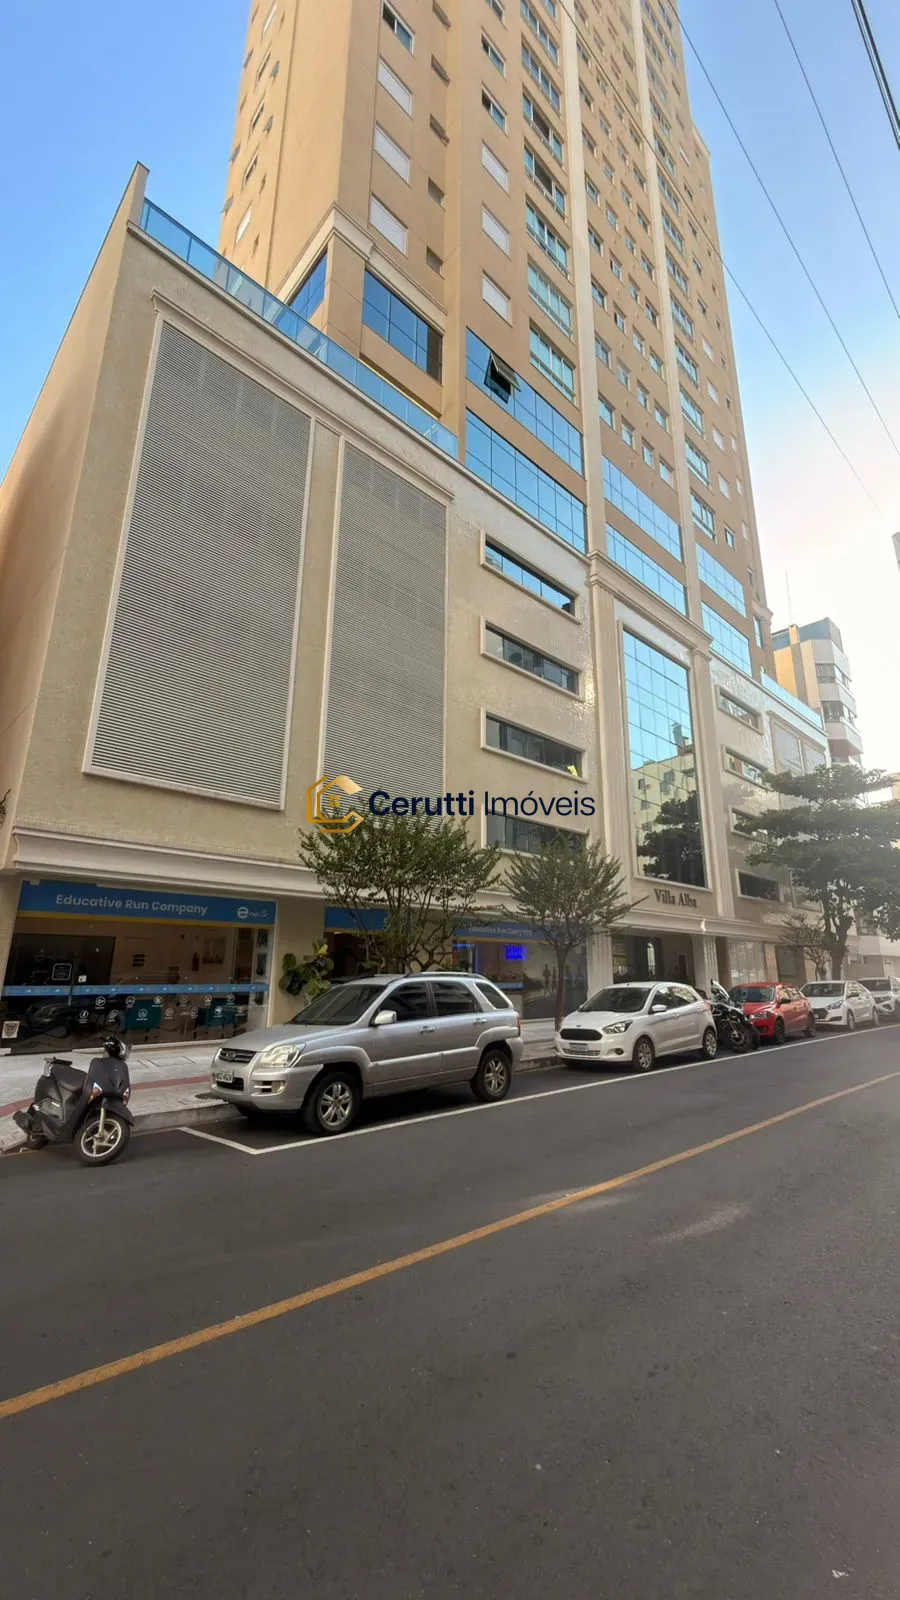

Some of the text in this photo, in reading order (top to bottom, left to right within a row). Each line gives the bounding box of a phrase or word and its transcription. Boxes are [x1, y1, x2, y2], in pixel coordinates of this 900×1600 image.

[55, 894, 208, 916] Educative Run Company
[654, 888, 697, 909] Villa Alba
